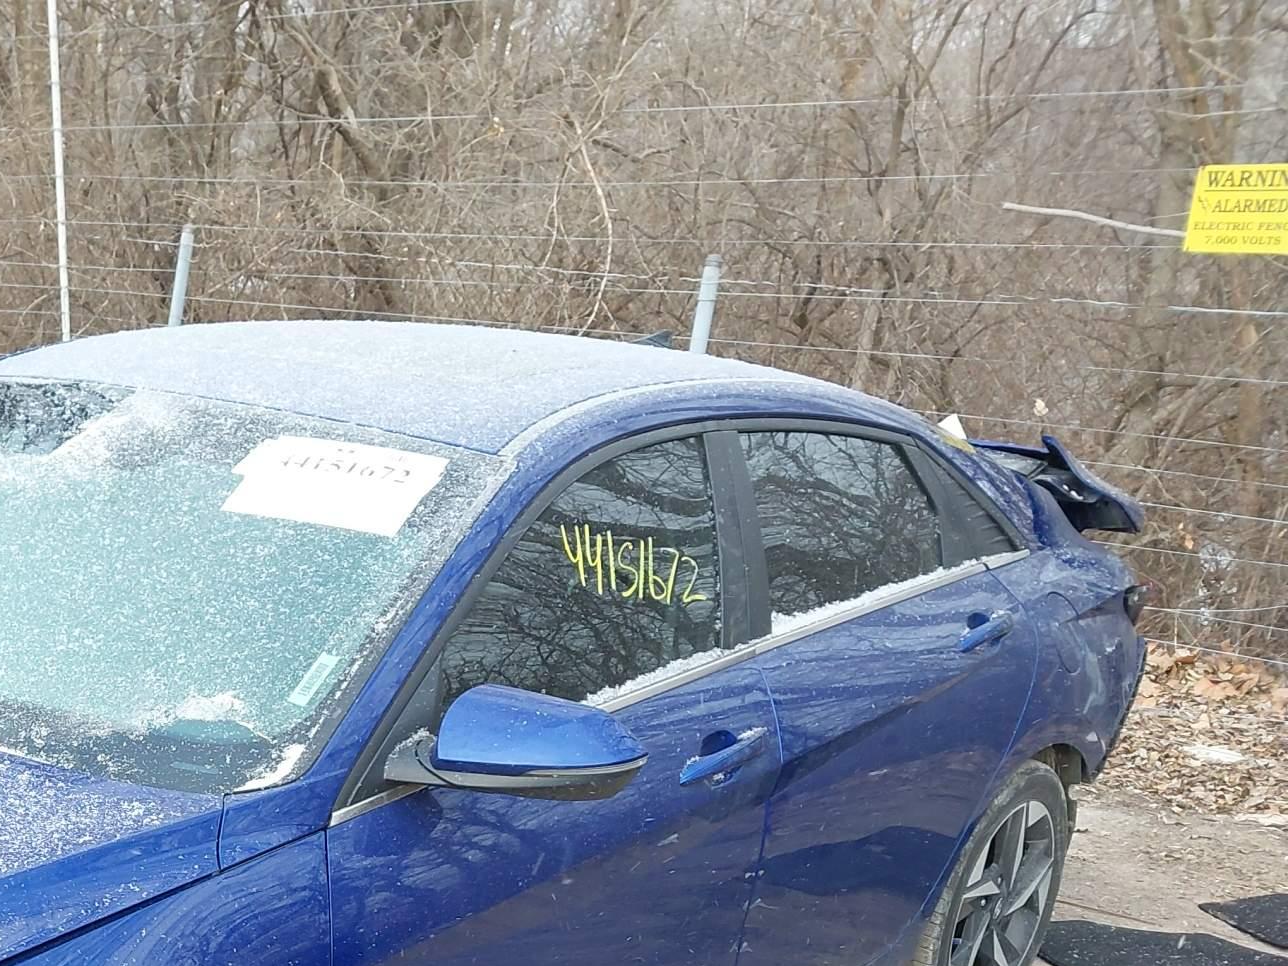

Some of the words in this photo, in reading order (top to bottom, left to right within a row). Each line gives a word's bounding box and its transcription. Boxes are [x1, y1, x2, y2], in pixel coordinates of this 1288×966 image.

[1211, 199, 1288, 212] ALARMED
[1194, 221, 1253, 230] ELECTRIC
[1242, 235, 1281, 245] VOLTS
[560, 524, 708, 605] 44151672
